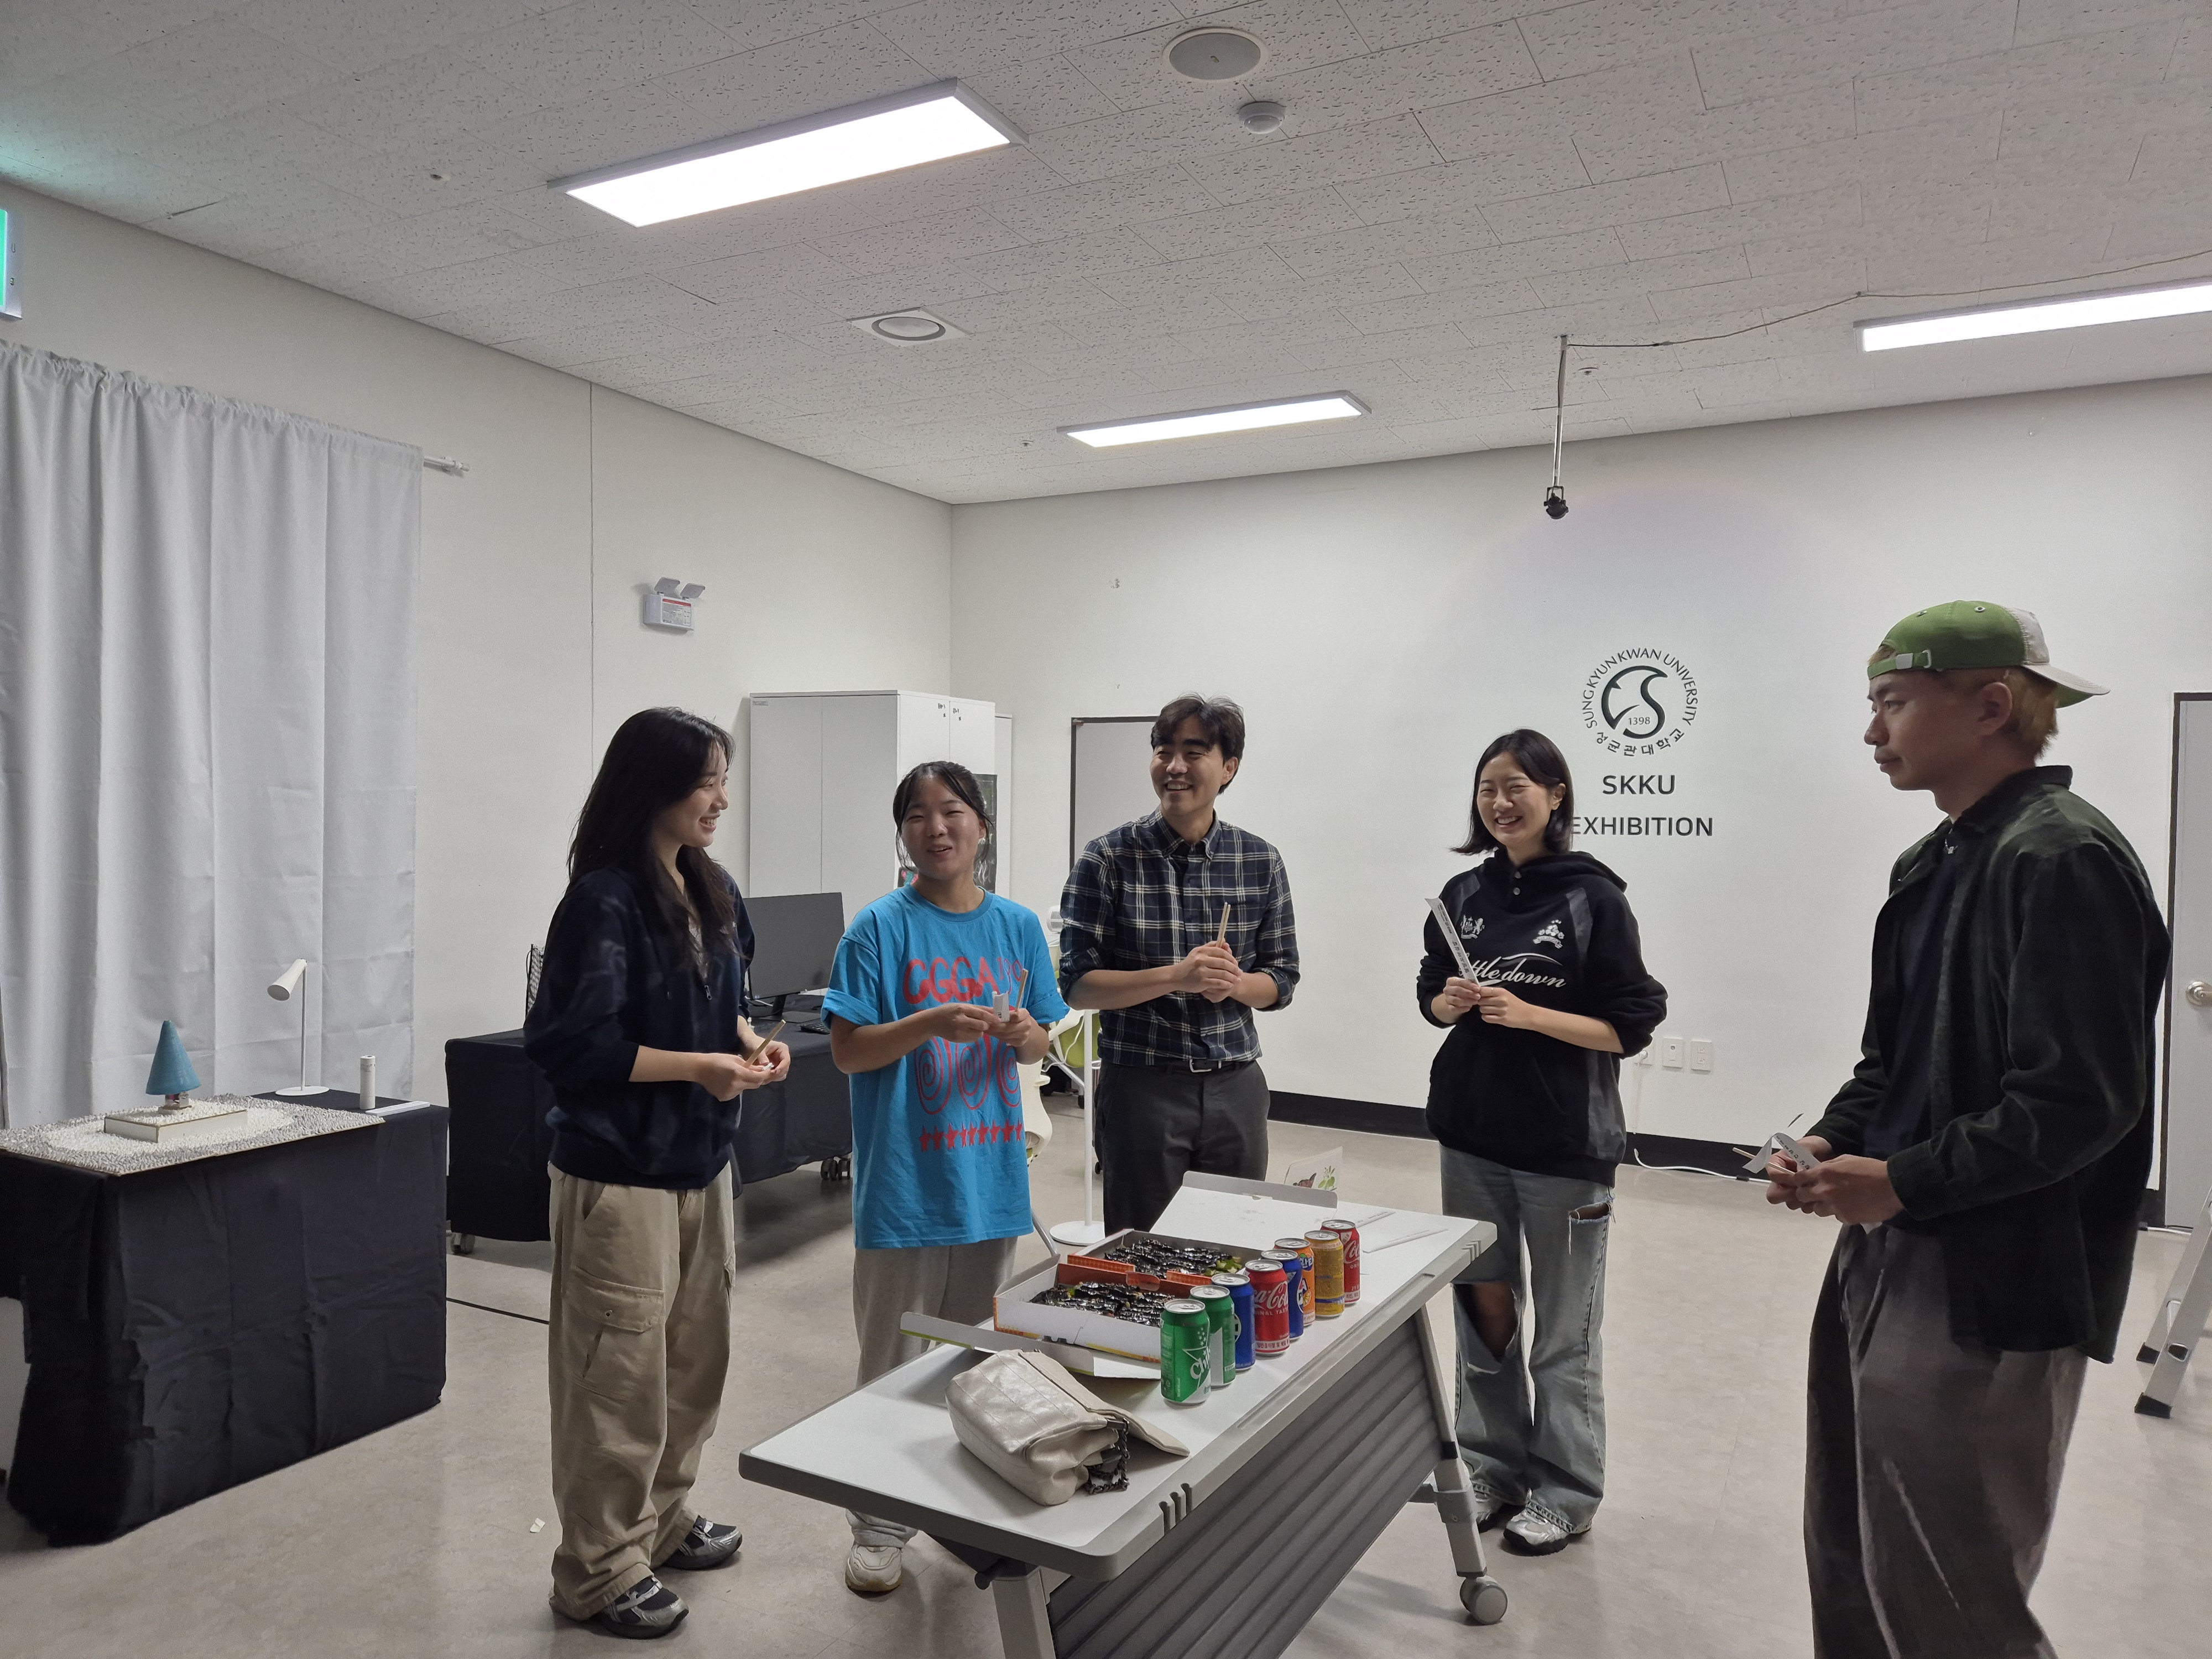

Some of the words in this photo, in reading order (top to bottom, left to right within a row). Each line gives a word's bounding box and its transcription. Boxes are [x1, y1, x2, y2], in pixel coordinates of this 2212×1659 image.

[1663, 653, 1698, 726] UNIVERSITY
[1628, 717, 1650, 725] 1398
[1597, 728, 1685, 757] 성균관대학교
[1603, 775, 1675, 795] SKKU
